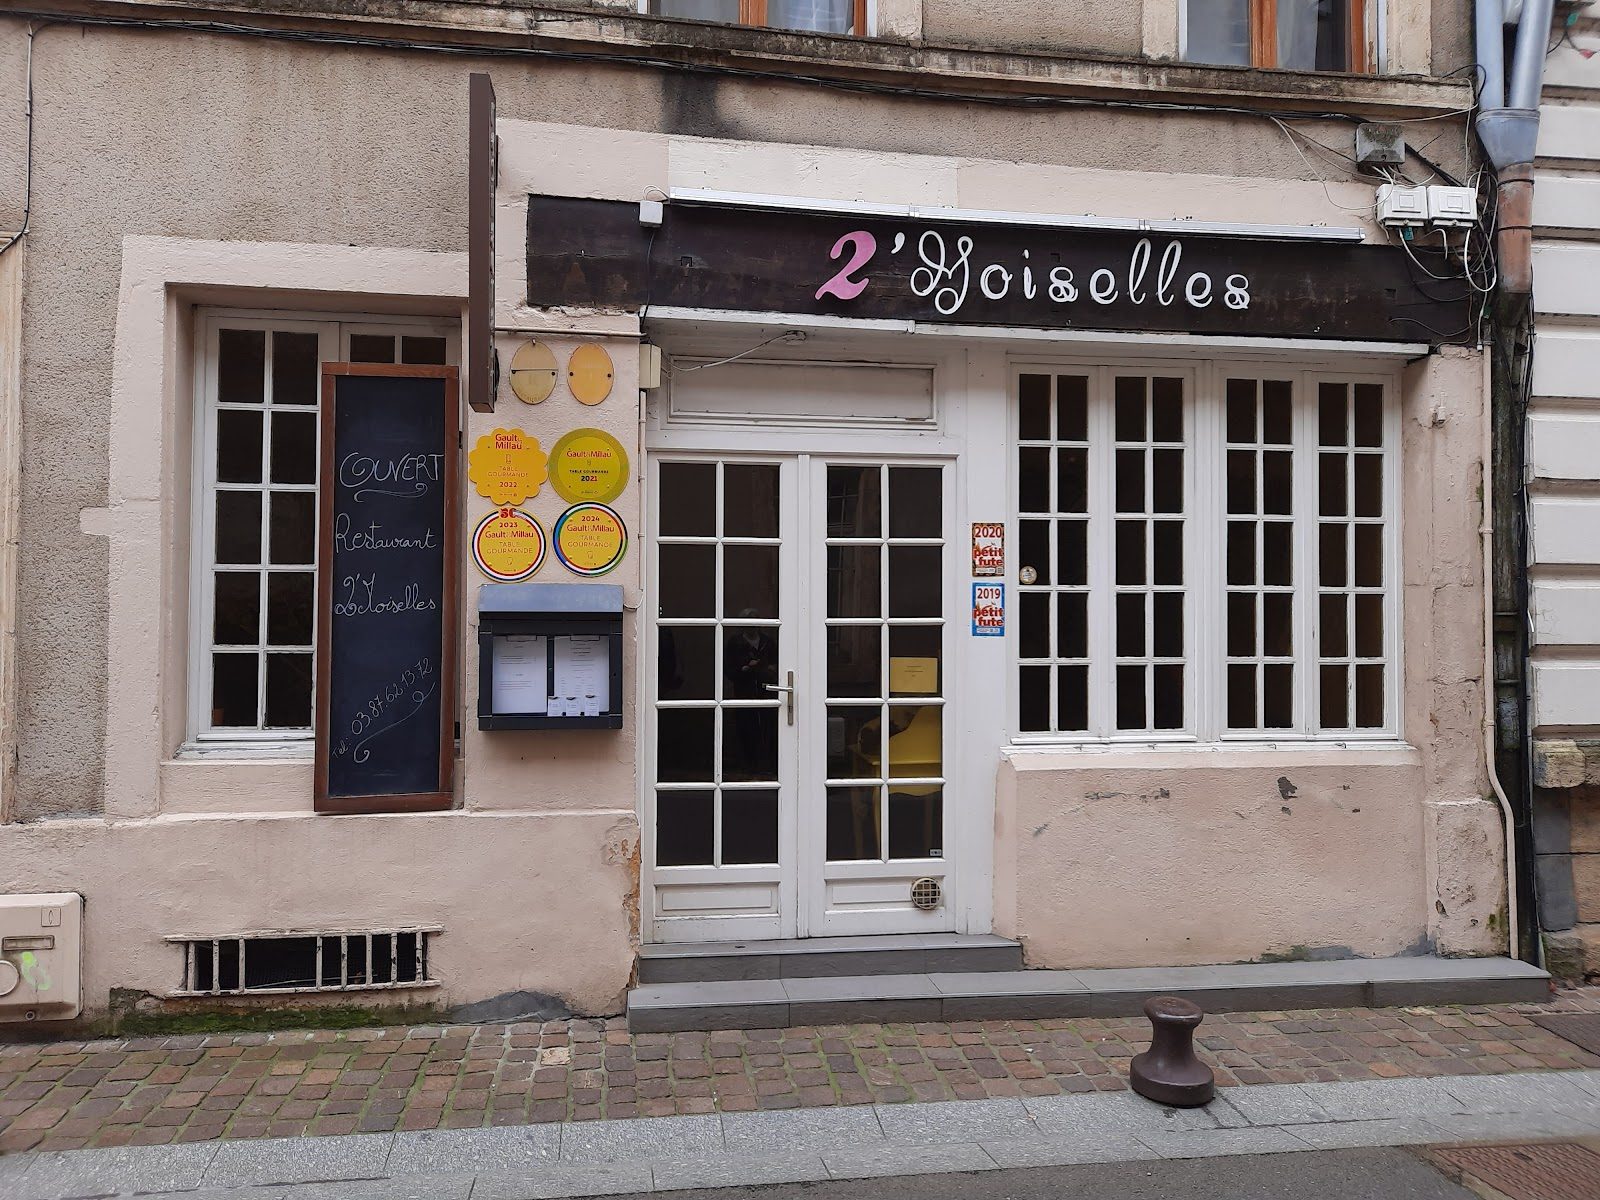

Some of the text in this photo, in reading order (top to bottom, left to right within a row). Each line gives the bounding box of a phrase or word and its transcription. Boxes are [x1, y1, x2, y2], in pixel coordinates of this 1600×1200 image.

[495, 441, 523, 450] Millau
[339, 452, 444, 488] OUVERT
[335, 513, 436, 554] Restaurant
[974, 526, 1002, 538] 2020
[973, 546, 1003, 559] petit
[977, 587, 1001, 599] 2019
[973, 606, 1004, 619] petit
